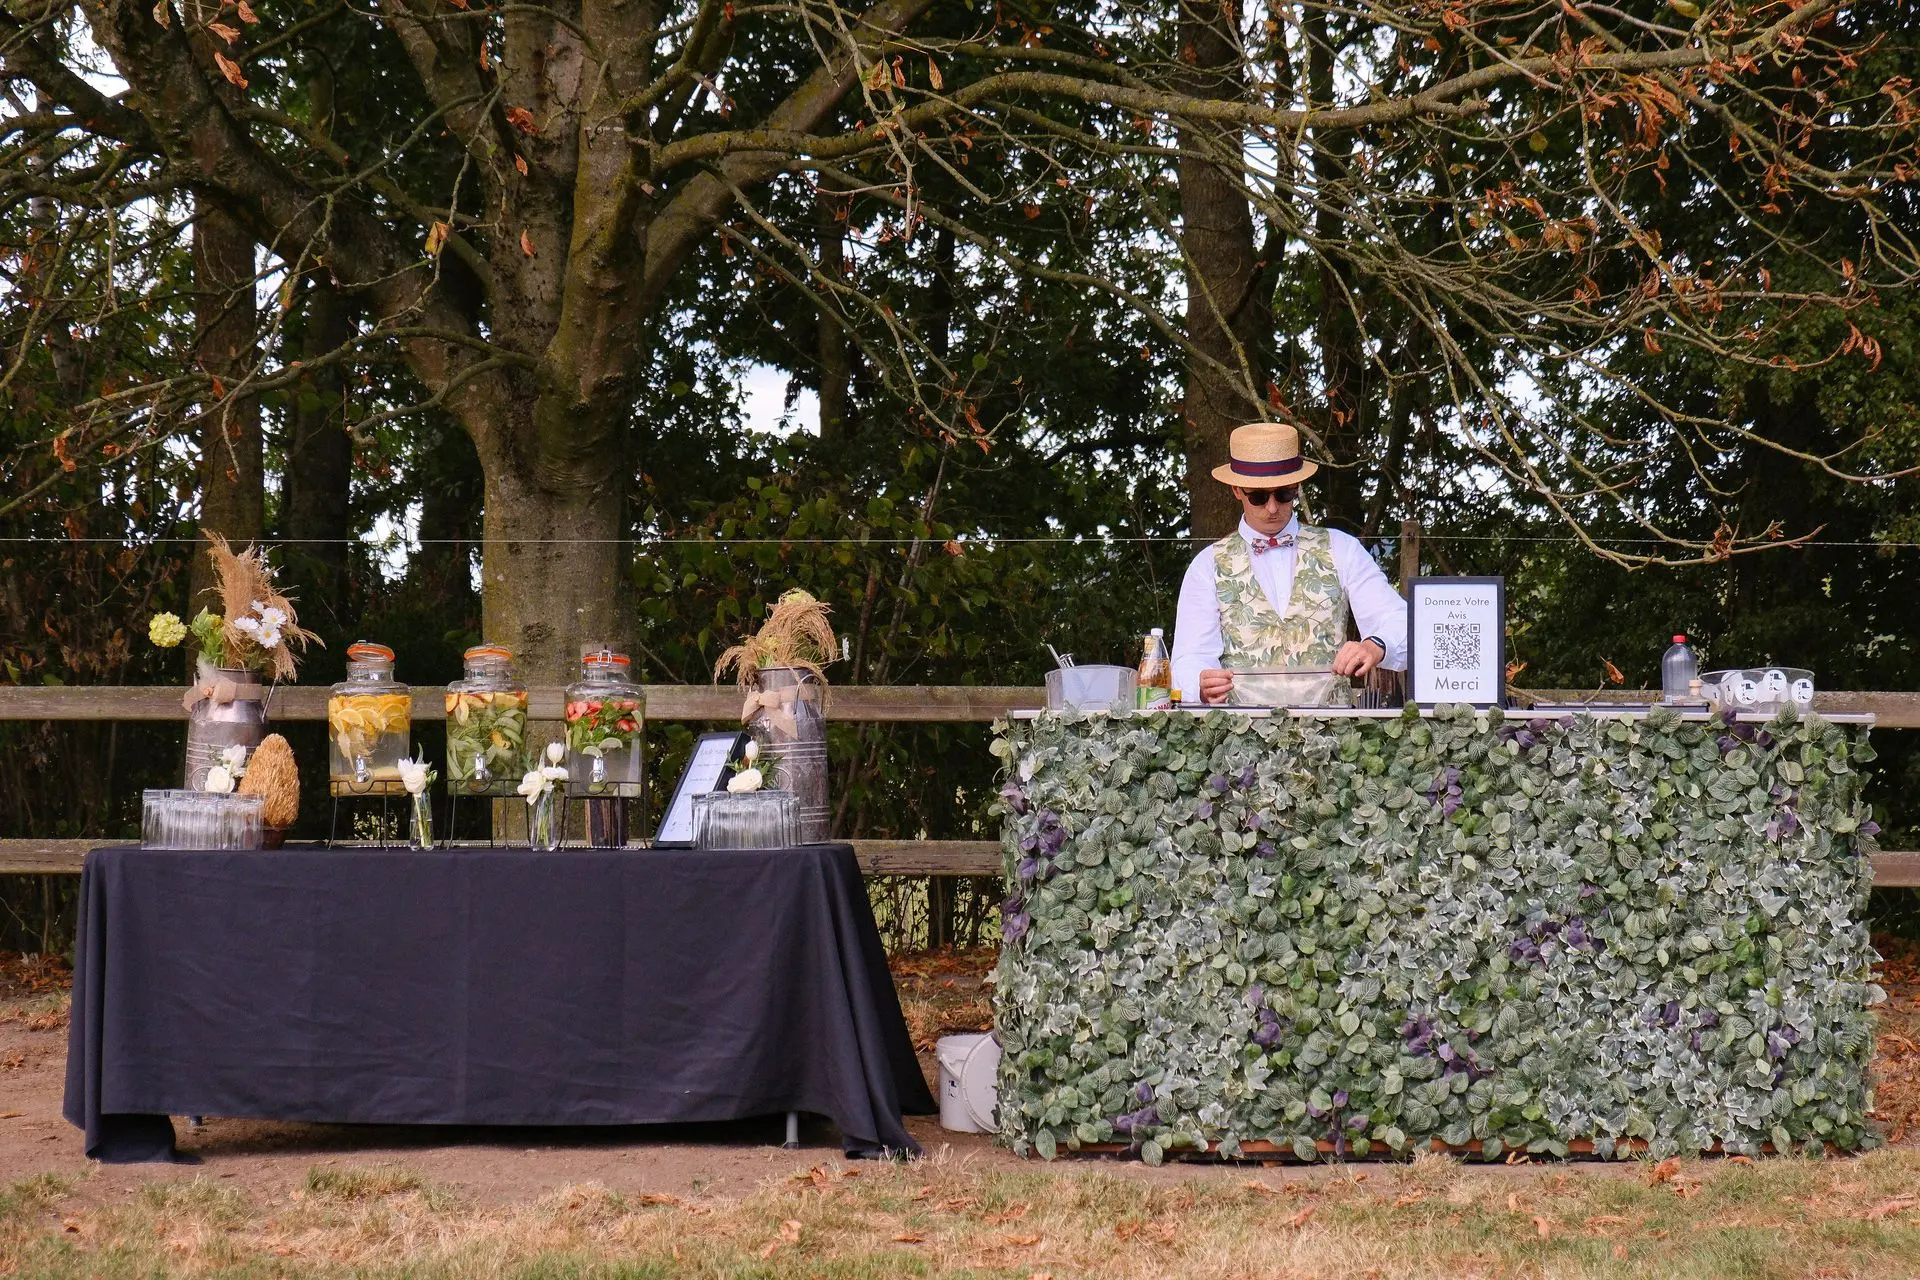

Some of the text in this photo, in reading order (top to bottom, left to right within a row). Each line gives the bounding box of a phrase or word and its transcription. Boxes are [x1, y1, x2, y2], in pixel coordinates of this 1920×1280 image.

[1424, 597, 1490, 606] Donnez Votre
[1447, 611, 1467, 620] Avis
[1434, 676, 1479, 690] Merci
